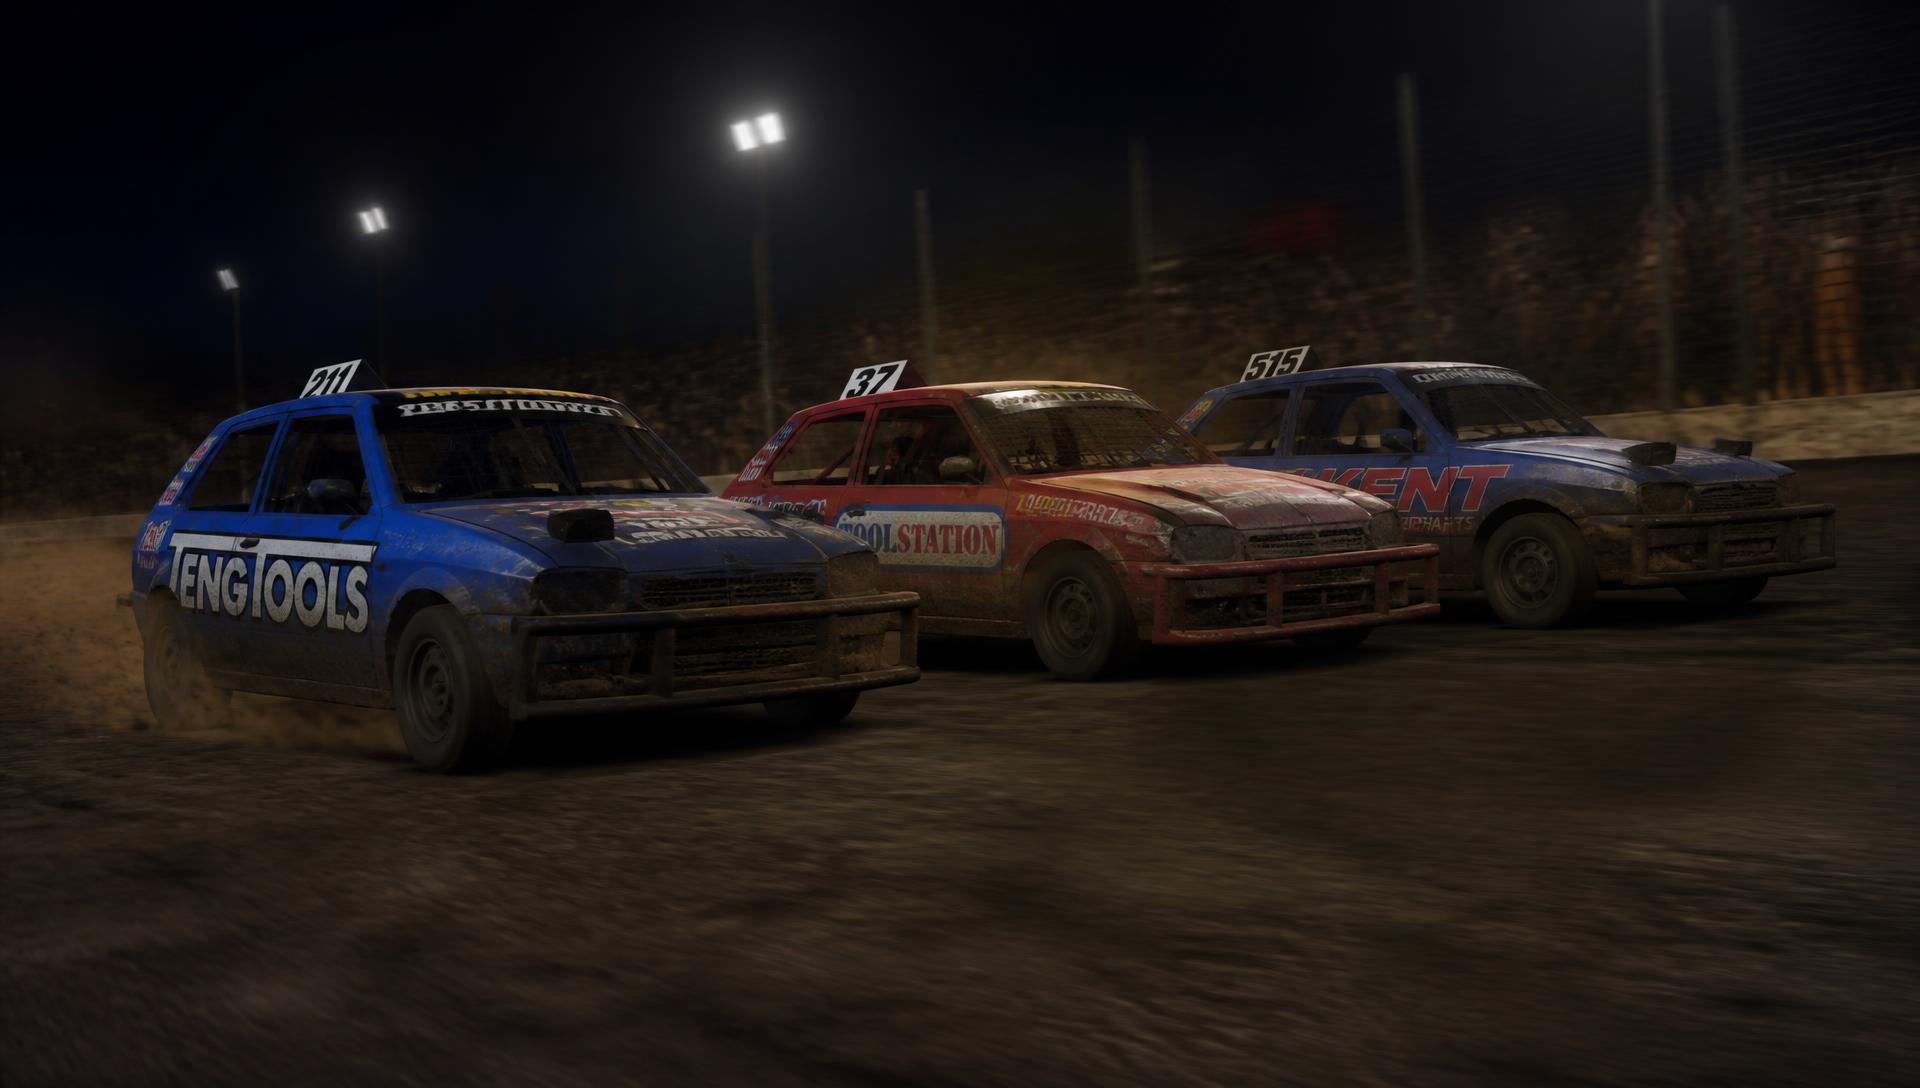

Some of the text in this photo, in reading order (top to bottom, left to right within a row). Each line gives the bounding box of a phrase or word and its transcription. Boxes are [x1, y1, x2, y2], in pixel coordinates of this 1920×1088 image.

[303, 364, 353, 398] 211
[1245, 349, 1302, 379] 515
[845, 364, 900, 399] 37
